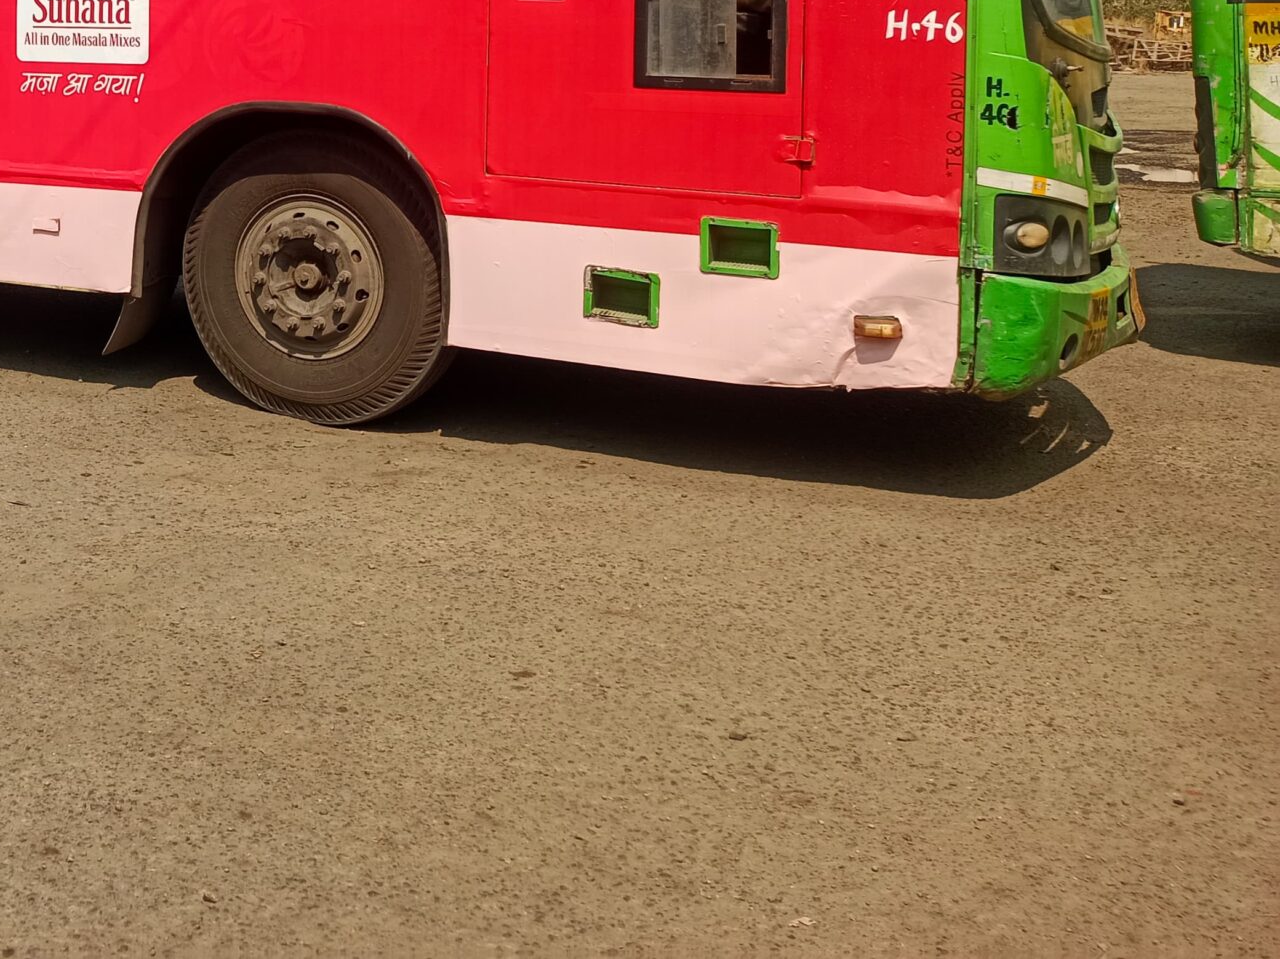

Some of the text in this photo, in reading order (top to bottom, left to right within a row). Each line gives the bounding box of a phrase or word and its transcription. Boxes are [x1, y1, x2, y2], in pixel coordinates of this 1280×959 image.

[24, 32, 141, 48] All in One Masala Mixes
[20, 72, 145, 103] मज़ा आ गया!
[946, 71, 966, 123] Apply
